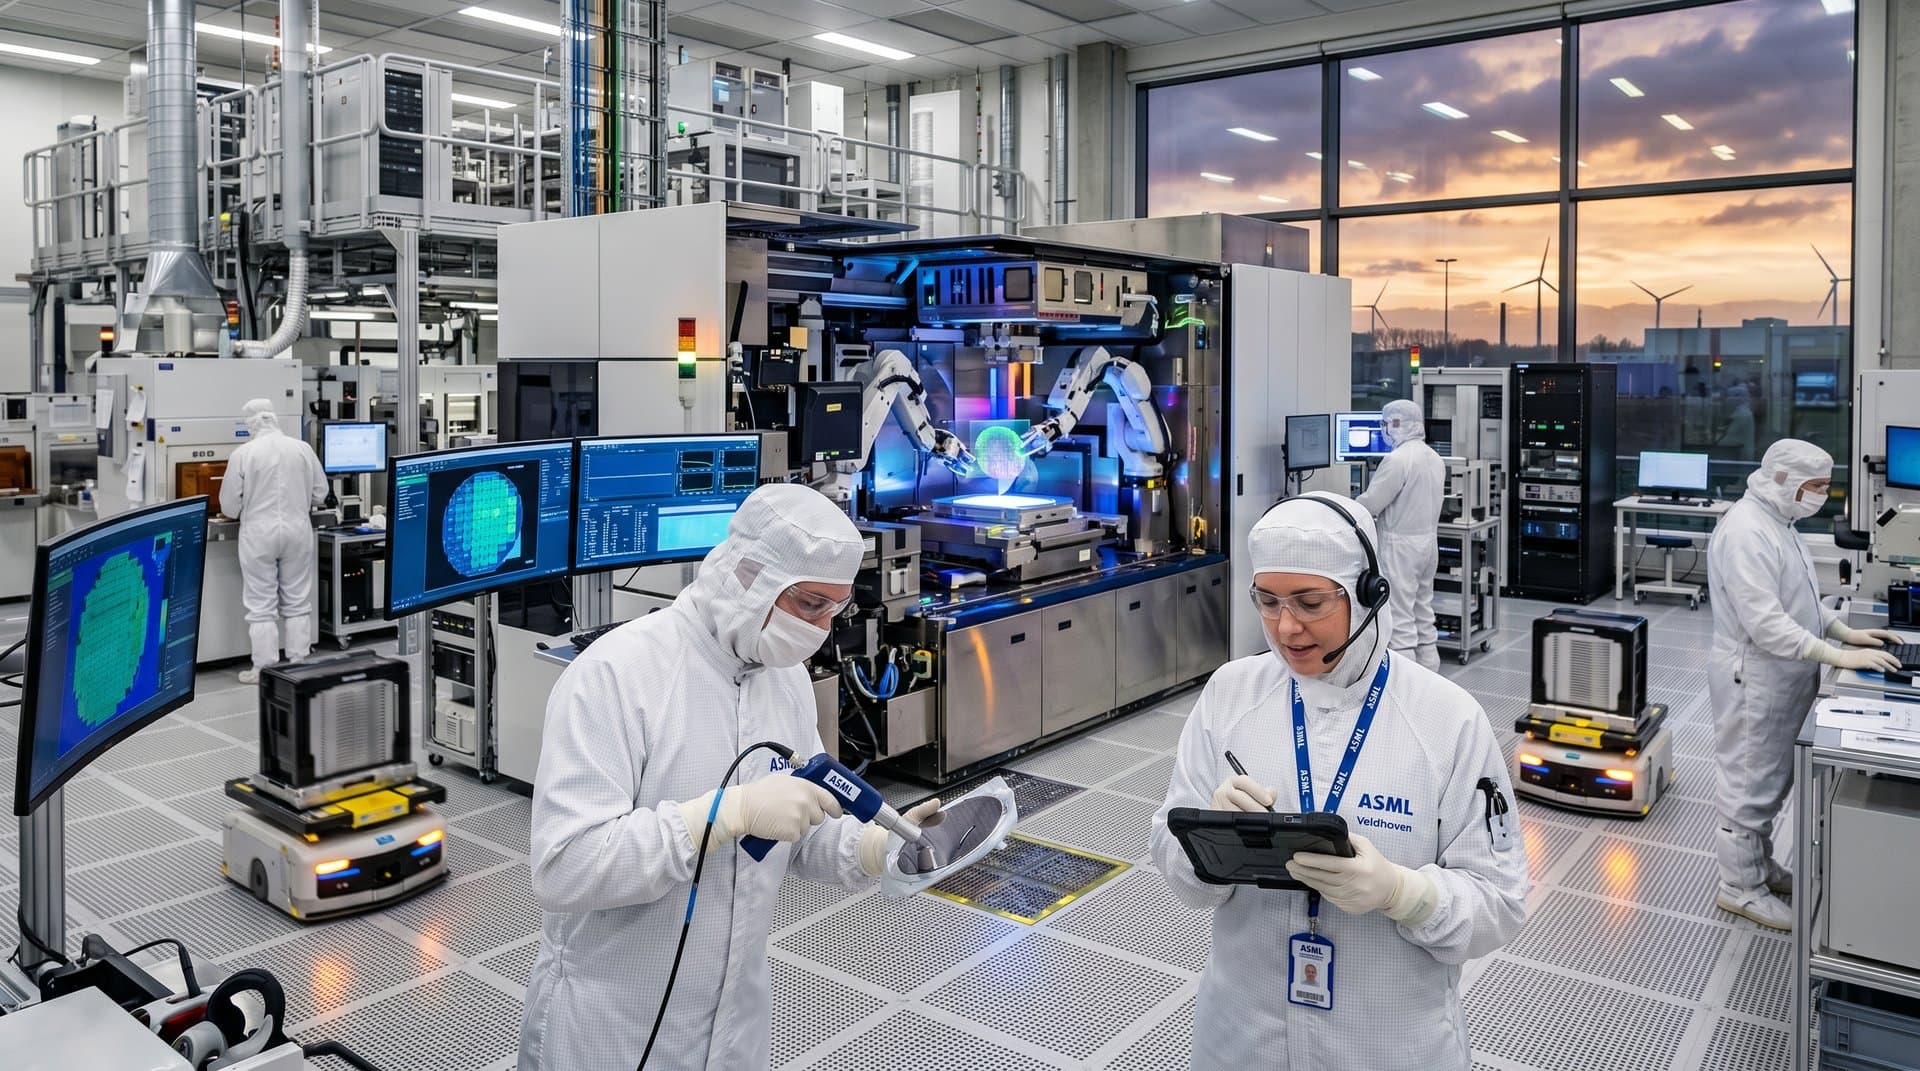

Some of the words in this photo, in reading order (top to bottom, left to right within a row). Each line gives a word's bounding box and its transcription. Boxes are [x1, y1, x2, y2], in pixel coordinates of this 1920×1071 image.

[1367, 686, 1381, 709] ASML
[1350, 729, 1365, 753] ASML
[829, 775, 853, 795] ASML
[1300, 770, 1309, 795] ASML
[1332, 771, 1348, 797] ASML
[1357, 793, 1414, 817] ASML
[1356, 815, 1412, 833] Veldhoven
[1300, 944, 1323, 955] ASML
